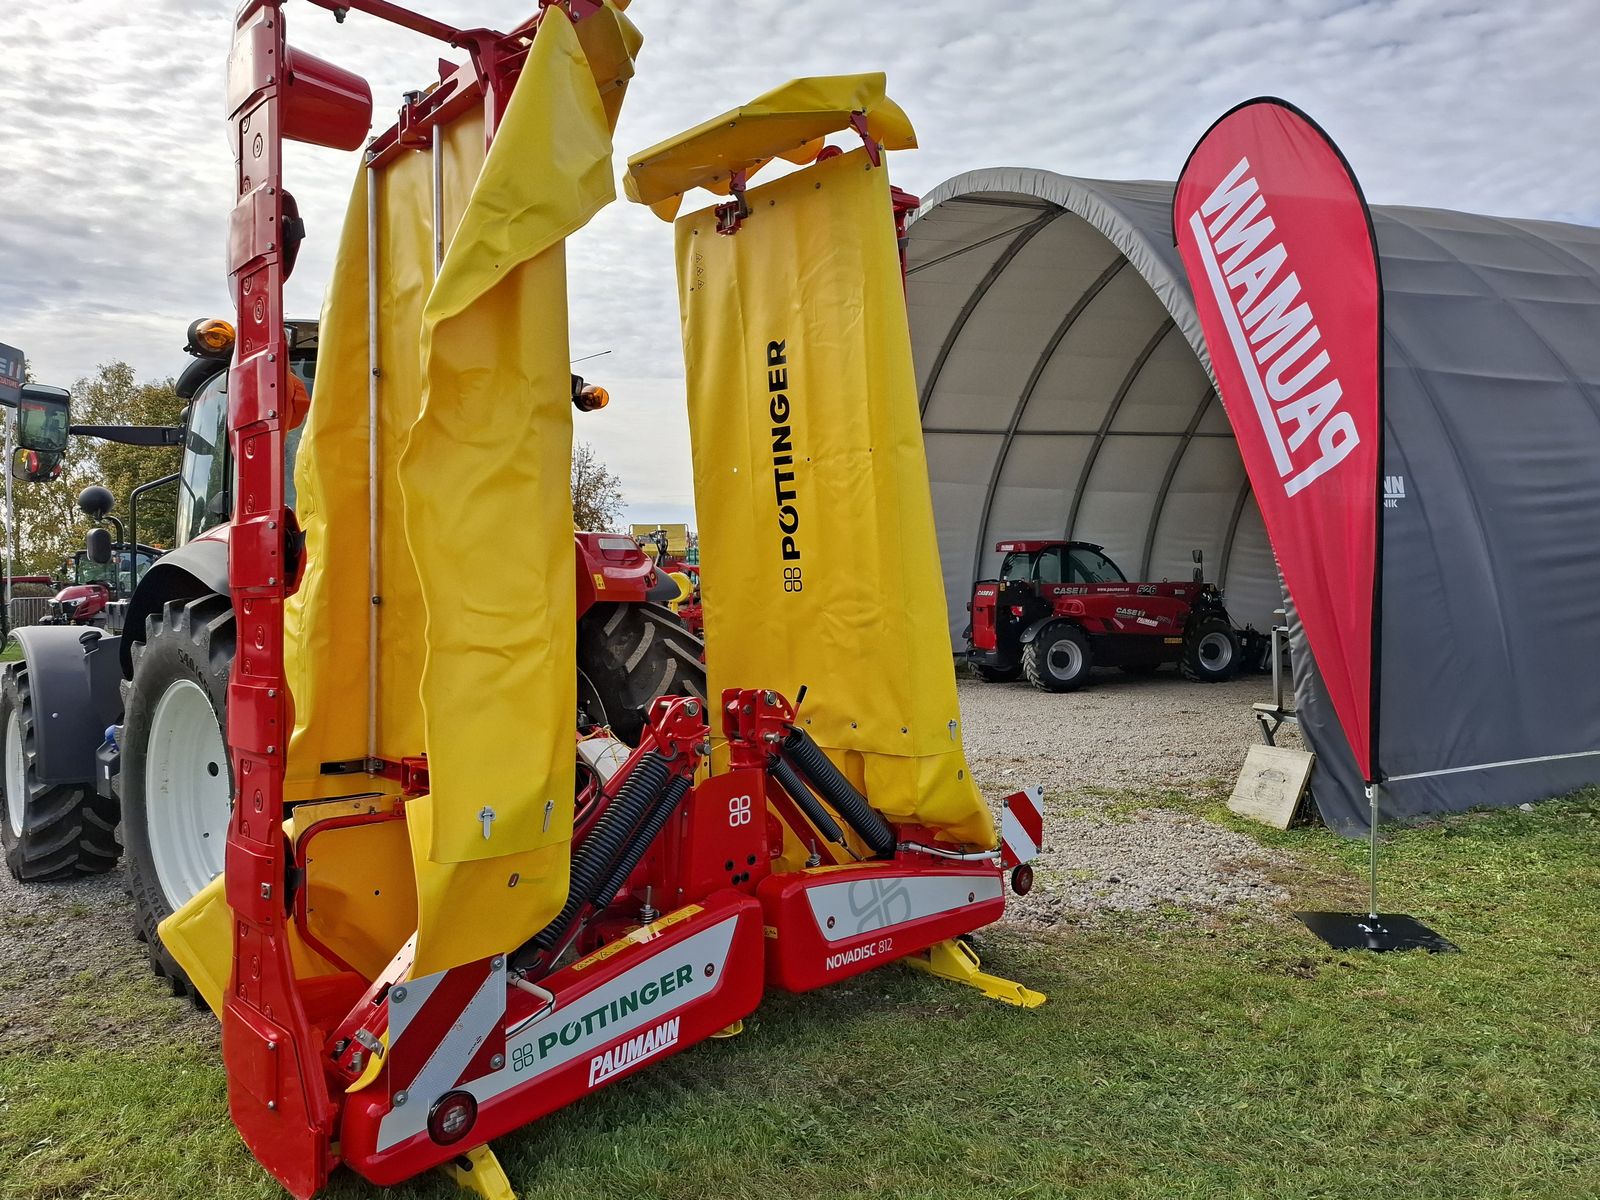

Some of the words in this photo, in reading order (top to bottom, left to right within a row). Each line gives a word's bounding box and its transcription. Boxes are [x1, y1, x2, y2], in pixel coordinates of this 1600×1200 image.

[766, 338, 801, 561] PÖTTINGER
[1116, 607, 1138, 616] CASE
[1136, 585, 1157, 594] 526
[826, 942, 876, 971] NOVADISC
[878, 937, 893, 954] 812
[537, 964, 693, 1060] PÖTTINGER
[588, 1016, 680, 1089] PAUMANN
